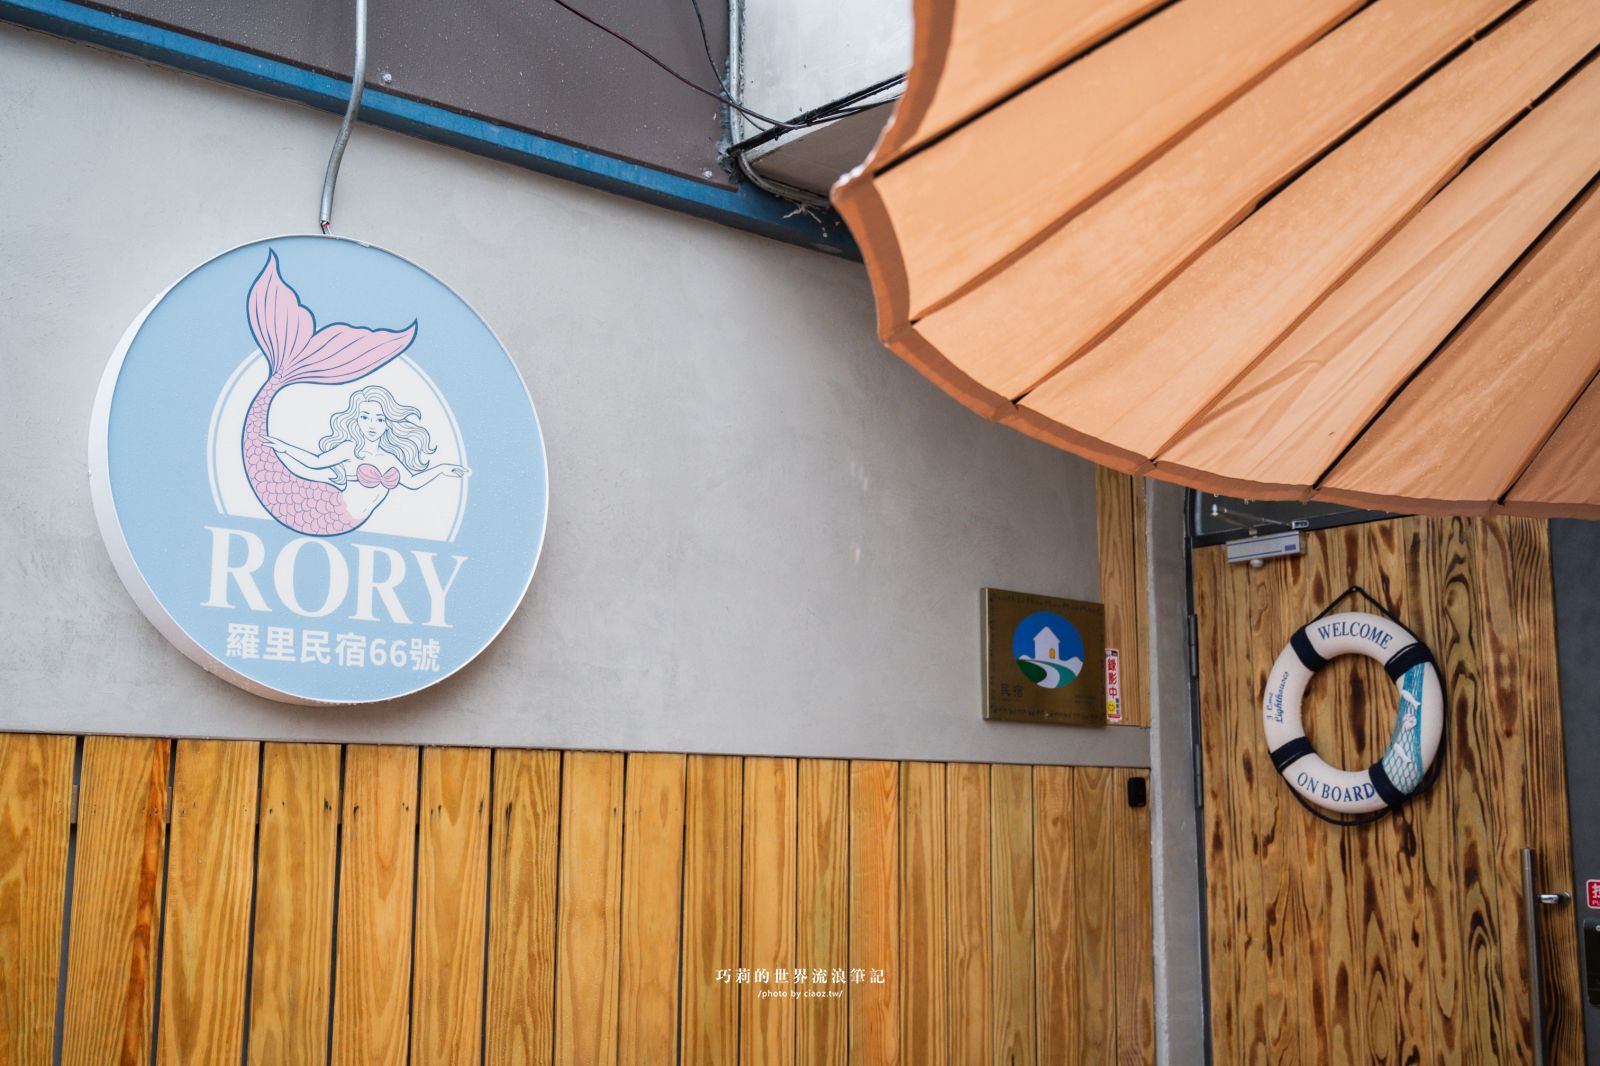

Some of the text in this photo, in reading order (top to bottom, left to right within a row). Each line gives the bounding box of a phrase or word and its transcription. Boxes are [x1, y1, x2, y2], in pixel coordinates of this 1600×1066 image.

[200, 526, 469, 628] RORY
[225, 623, 441, 673] 羅里民宿66號
[1317, 621, 1393, 650] WELCOME
[1297, 772, 1376, 802] ON BOARD
